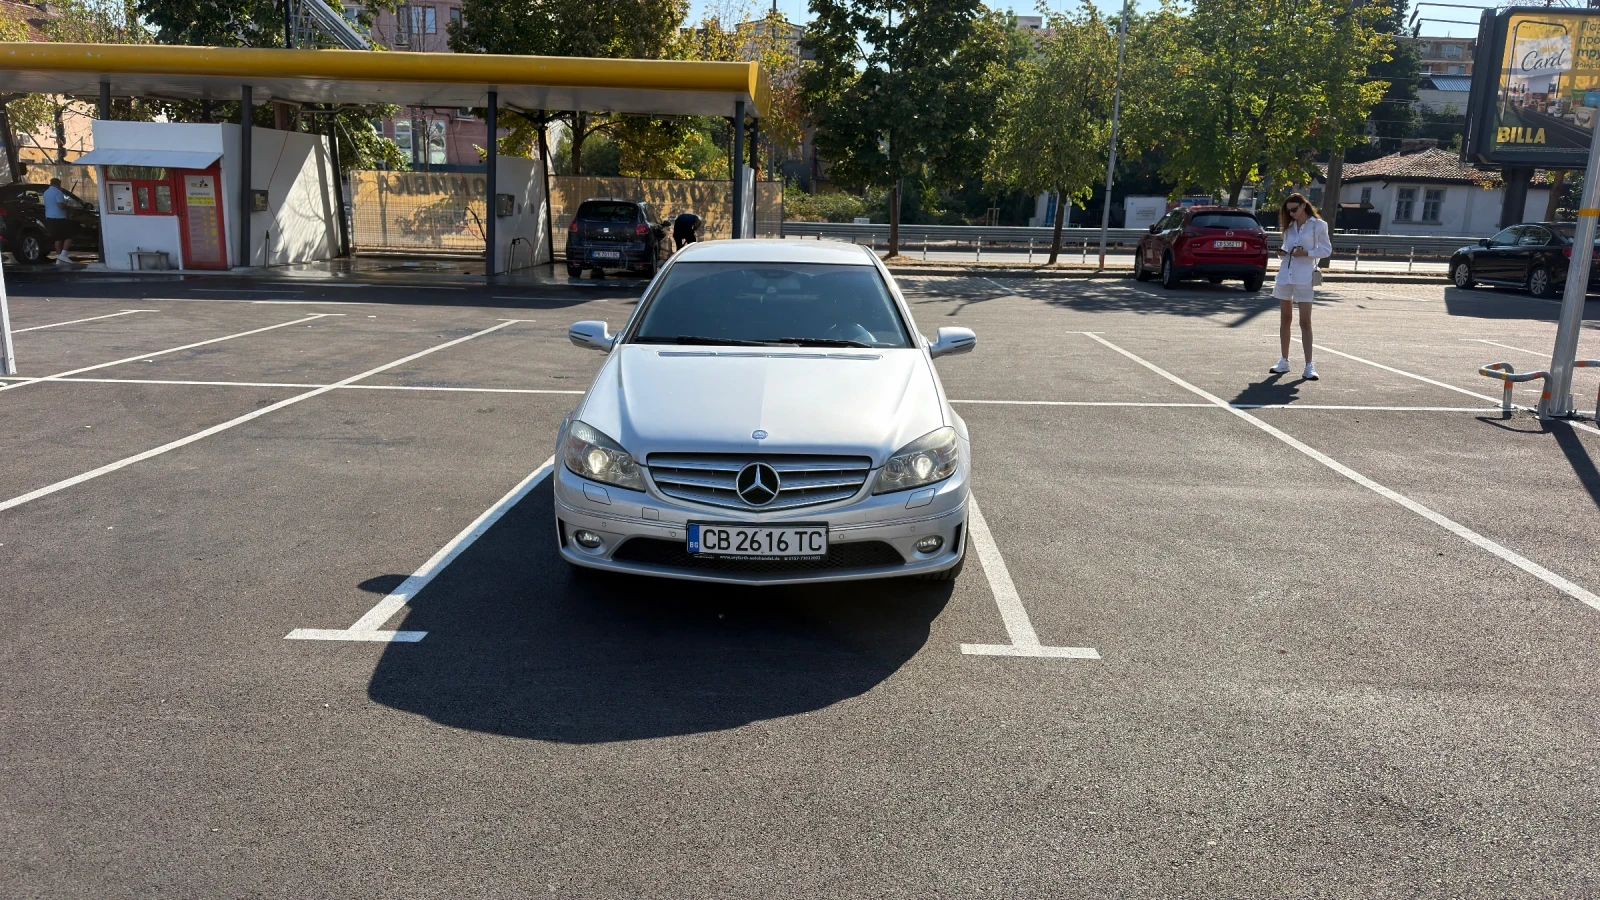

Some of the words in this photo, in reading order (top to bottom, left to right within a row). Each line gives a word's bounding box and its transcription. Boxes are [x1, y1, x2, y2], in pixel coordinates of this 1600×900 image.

[1521, 48, 1566, 72] Card
[1496, 126, 1546, 144] BILLA
[689, 541, 699, 549] BG
[703, 529, 731, 550] CB
[735, 530, 789, 552] 2616
[794, 531, 822, 552] TC
